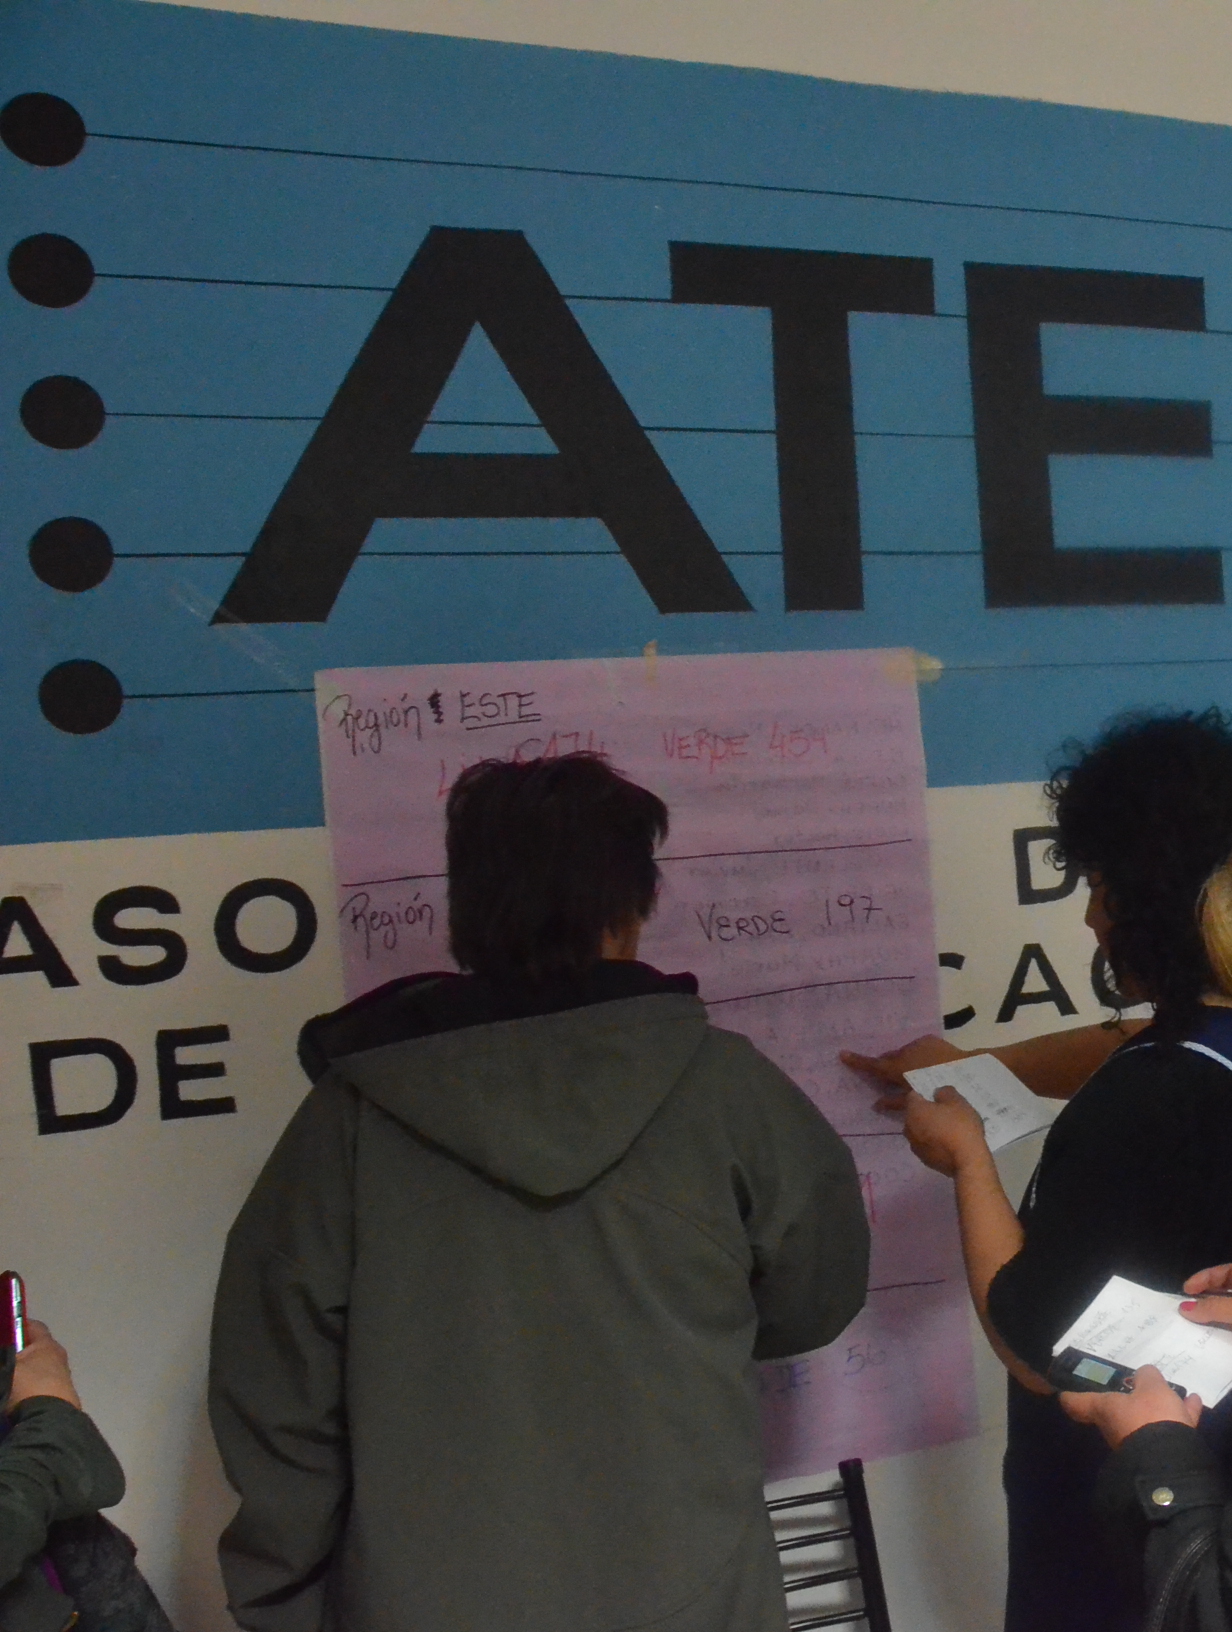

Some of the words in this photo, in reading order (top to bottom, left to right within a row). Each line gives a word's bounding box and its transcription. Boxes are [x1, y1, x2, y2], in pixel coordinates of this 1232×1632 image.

[458, 690, 543, 724] ESTE
[662, 727, 750, 775] VERDE
[0, 877, 318, 988] ASO
[697, 909, 791, 942] VERDE
[28, 1023, 238, 1136] DE
